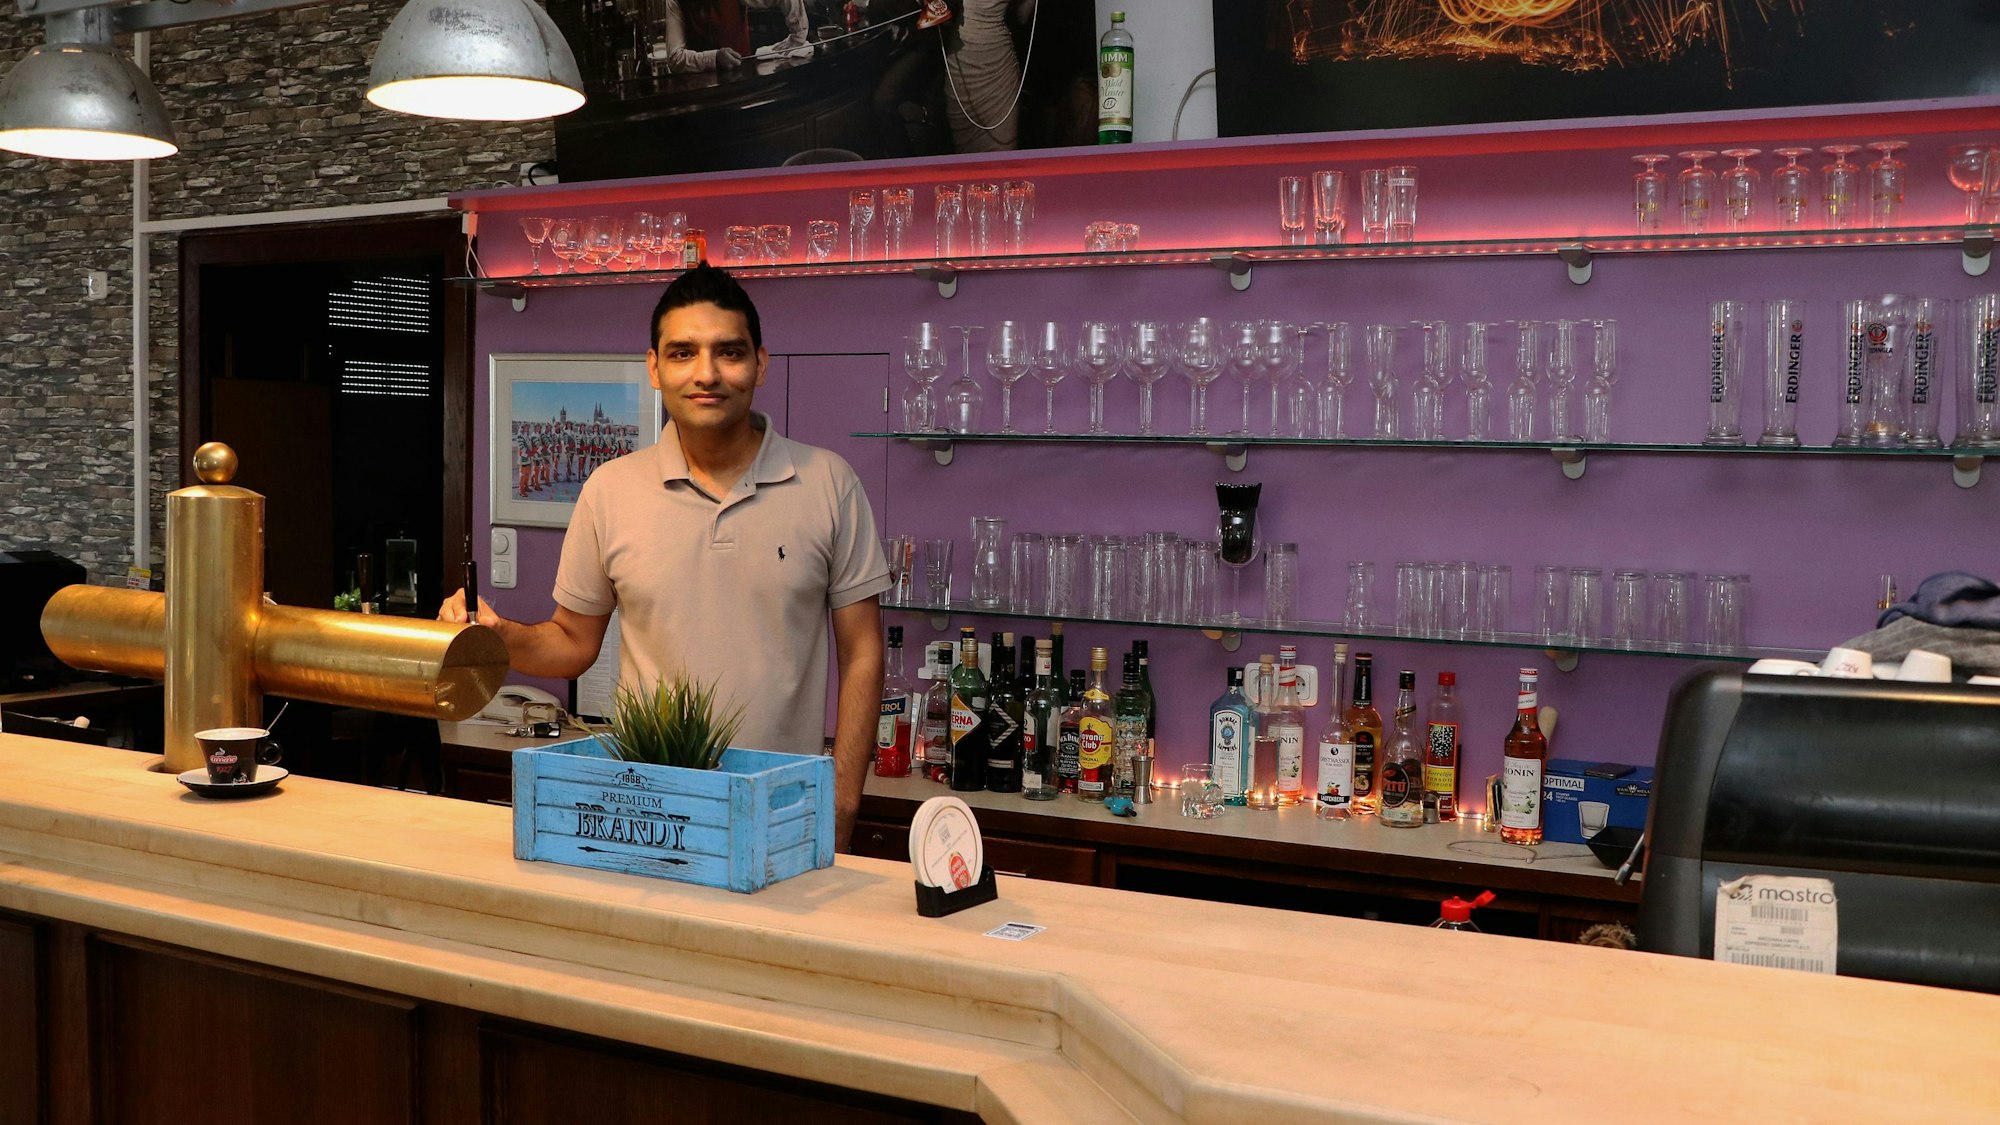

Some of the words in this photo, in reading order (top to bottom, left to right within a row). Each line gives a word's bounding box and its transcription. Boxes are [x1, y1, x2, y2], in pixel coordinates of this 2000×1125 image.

[1710, 333, 1725, 403] ERDINGER
[1785, 334, 1802, 403] ERDINGER
[1846, 333, 1864, 404] ERDINGER
[1912, 333, 1932, 404] ERDINGER
[1082, 740, 1097, 749] Club
[575, 802, 690, 850] BRANDY
[601, 791, 663, 808] PREMIUM
[1759, 888, 1834, 904] mastro
